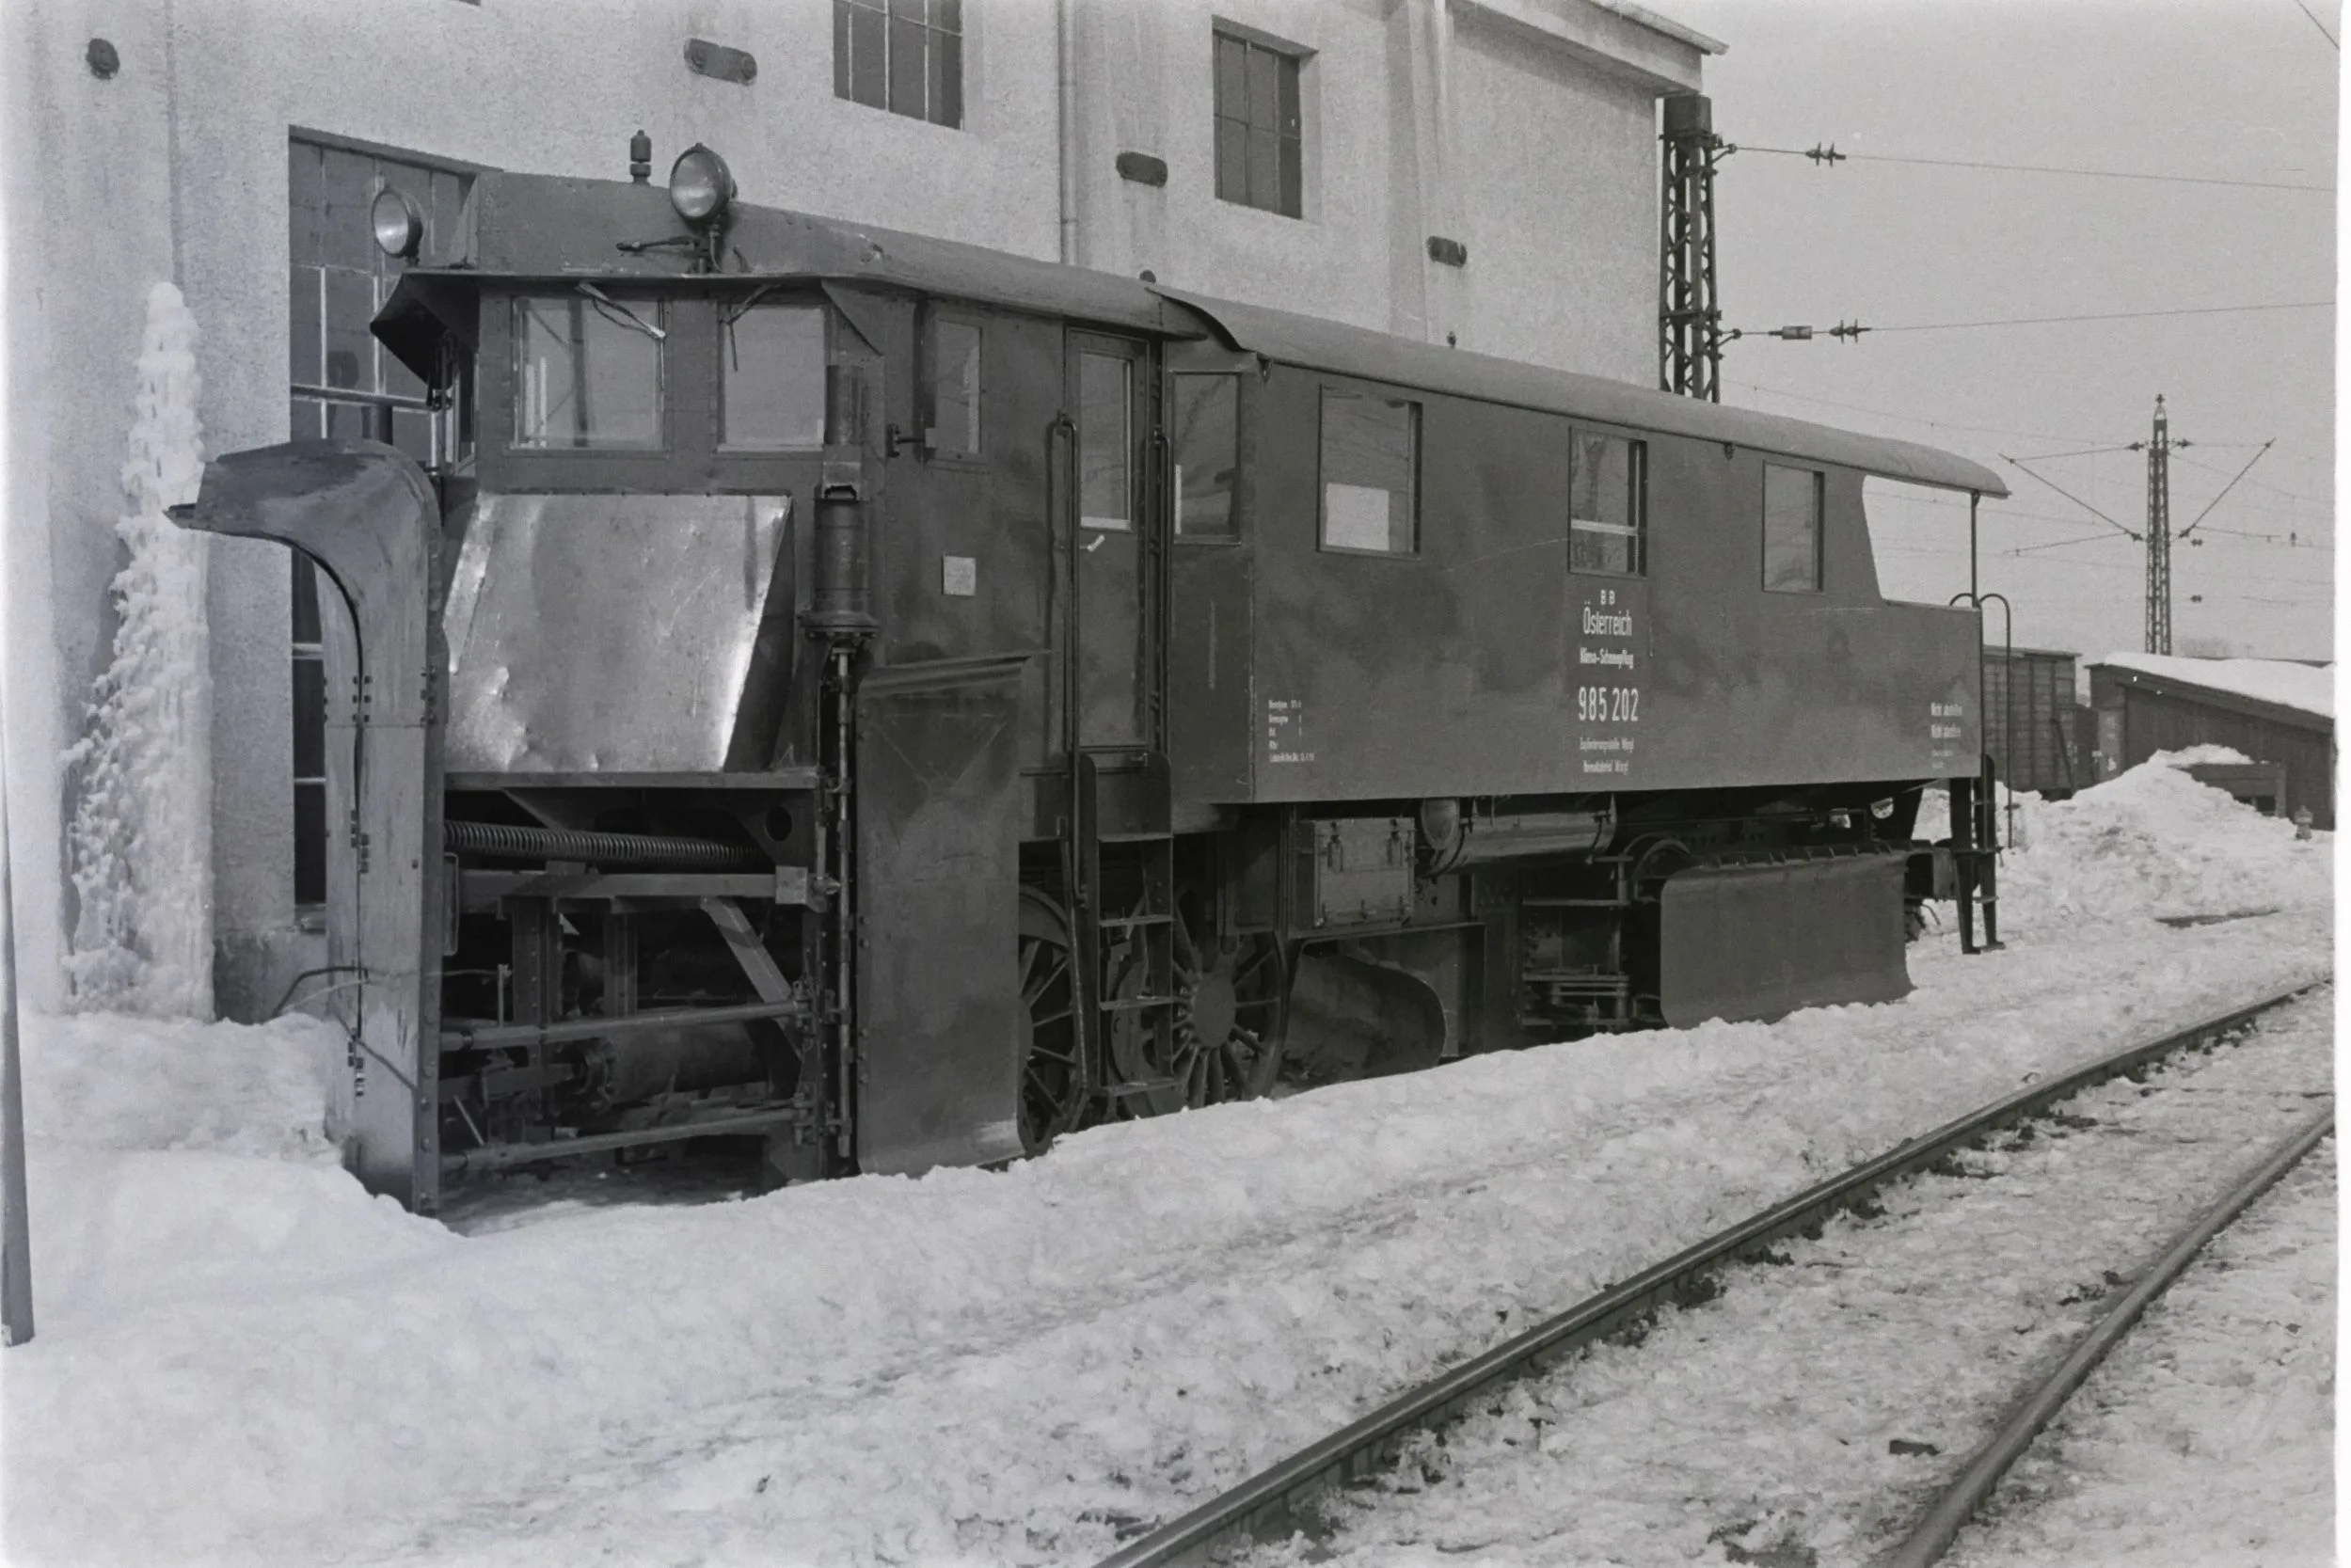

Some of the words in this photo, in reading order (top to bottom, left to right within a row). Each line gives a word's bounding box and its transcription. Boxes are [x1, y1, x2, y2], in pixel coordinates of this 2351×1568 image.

[1583, 600, 1632, 636] Österreich
[1579, 686, 1607, 722] 985
[1612, 687, 1639, 722] 202
